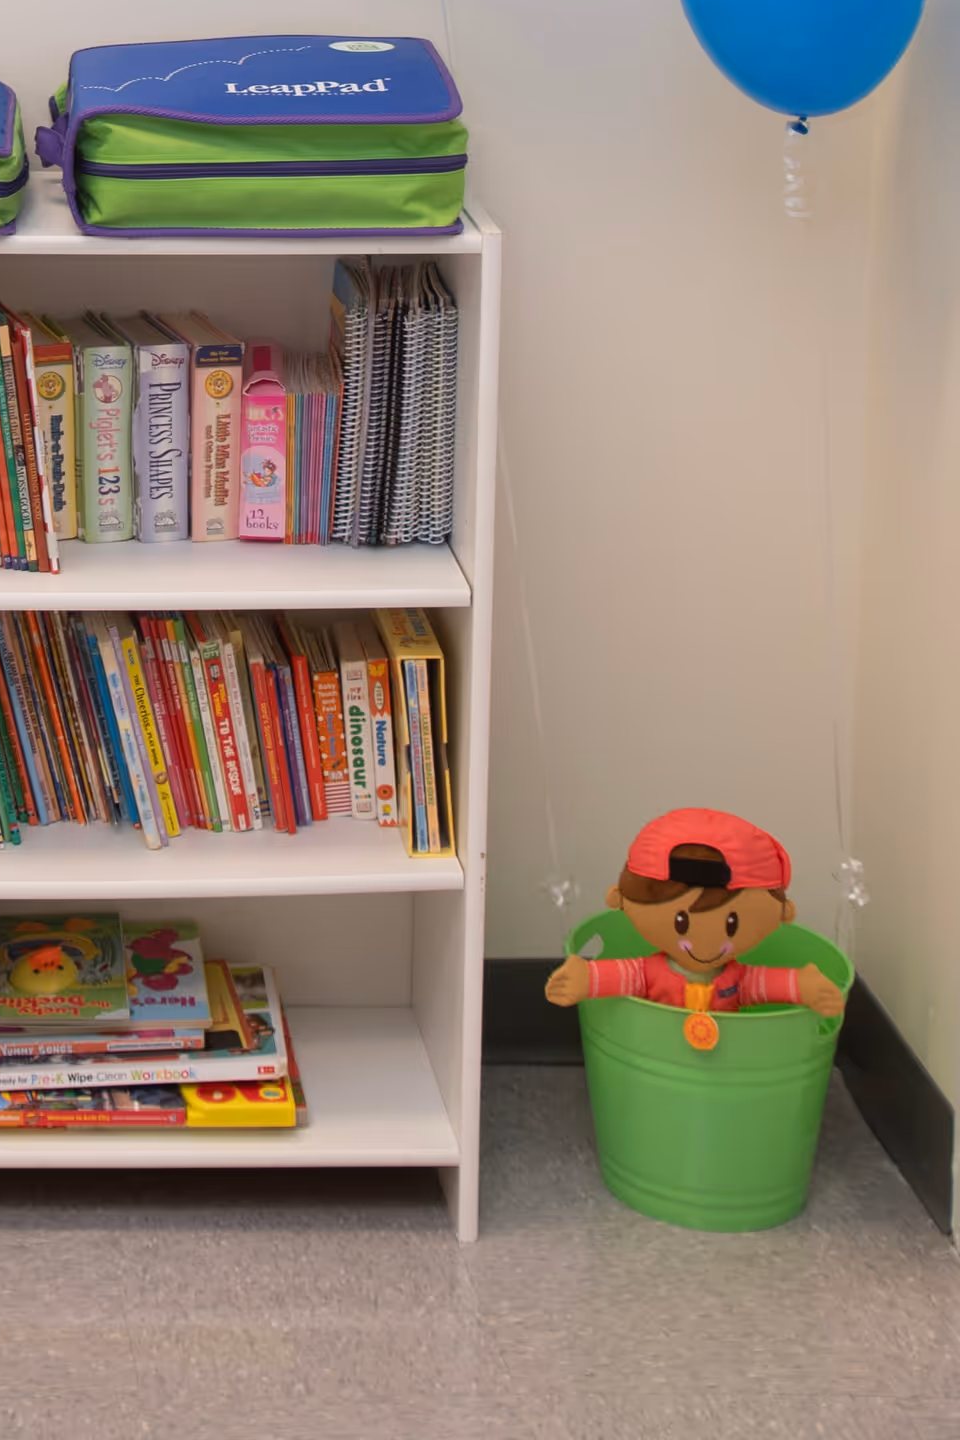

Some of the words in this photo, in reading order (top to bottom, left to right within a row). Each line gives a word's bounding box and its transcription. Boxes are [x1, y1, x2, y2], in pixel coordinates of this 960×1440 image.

[224, 78, 389, 97] LeapPad
[90, 353, 128, 369] Disney
[150, 352, 185, 369] Disney
[147, 382, 182, 445] PRINCESS
[89, 407, 122, 461] Piglet's
[215, 414, 232, 443] Little
[16, 466, 27, 493] MOSS
[23, 413, 32, 443] LITTLE
[28, 462, 38, 492] RIDING
[33, 495, 41, 520] HOOD
[148, 448, 183, 500] SHAPES
[19, 497, 30, 525] GOOD
[246, 514, 279, 530] books
[249, 508, 264, 520] 12
[135, 687, 150, 731] Cheerios
[222, 736, 234, 758] THE
[349, 706, 367, 789] dinosaur
[376, 721, 388, 766] Nature
[226, 761, 242, 795] RESCUE
[17, 1006, 80, 1016] Lucky
[129, 996, 197, 1007] Here's
[68, 1072, 93, 1083] Wipe
[96, 1072, 128, 1081] Clean
[130, 1067, 199, 1081] Workbook
